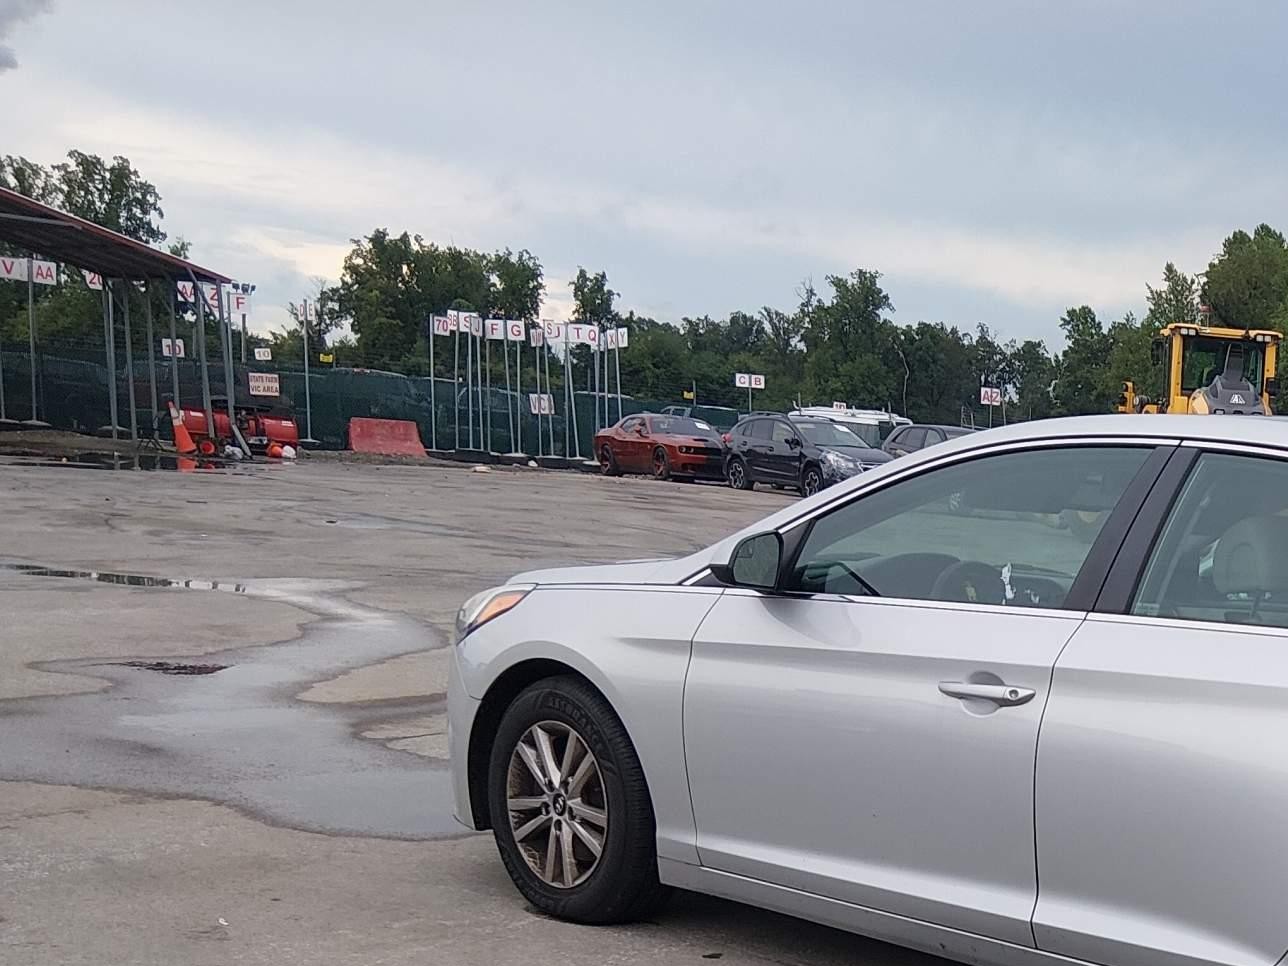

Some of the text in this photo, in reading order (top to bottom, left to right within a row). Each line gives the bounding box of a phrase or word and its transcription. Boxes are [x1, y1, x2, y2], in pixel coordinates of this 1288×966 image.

[2, 260, 14, 274] V
[35, 264, 54, 281] AA
[236, 296, 245, 310] F
[436, 319, 448, 332] 70
[490, 323, 498, 336] F
[511, 324, 521, 337] G
[573, 327, 582, 339] T
[588, 329, 597, 342] Q
[738, 375, 746, 385] C
[754, 377, 762, 386] B
